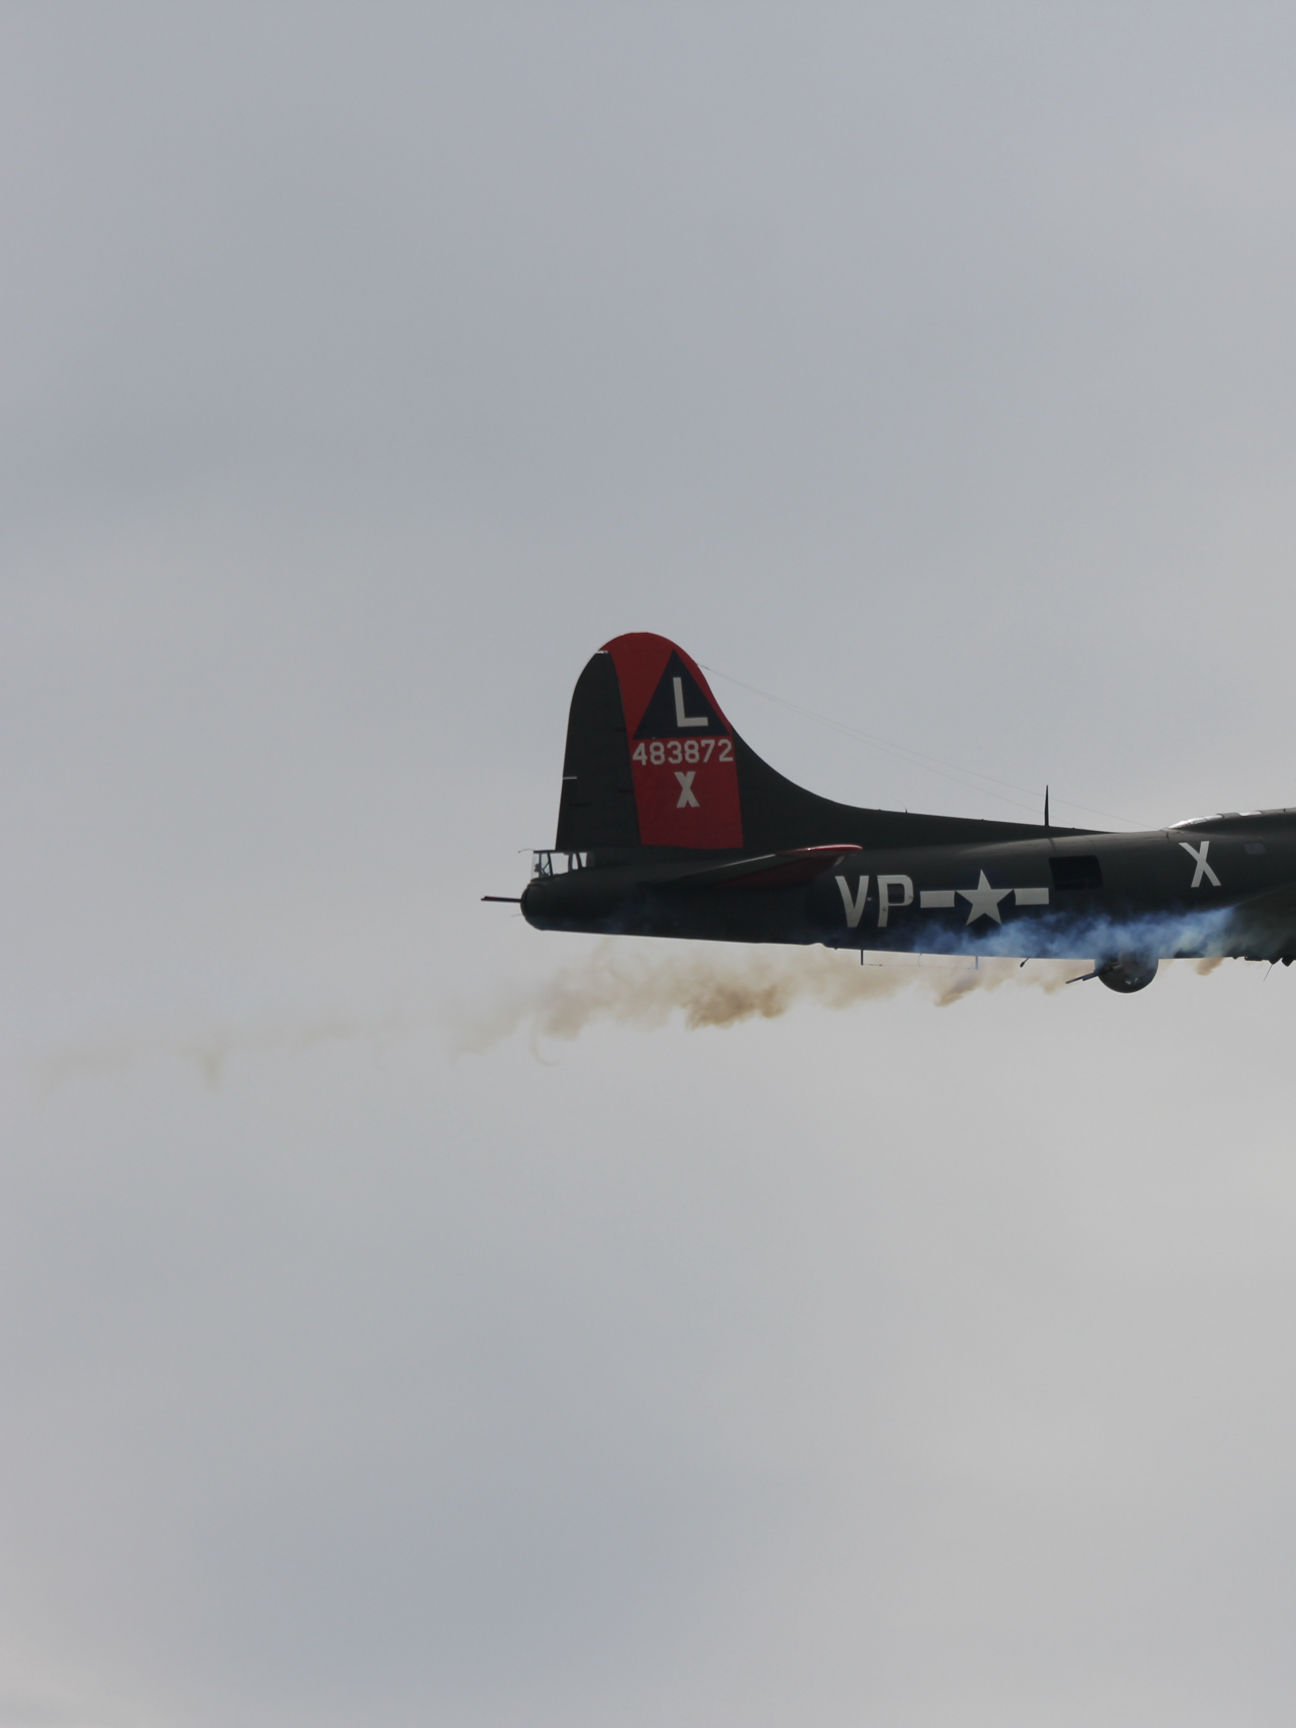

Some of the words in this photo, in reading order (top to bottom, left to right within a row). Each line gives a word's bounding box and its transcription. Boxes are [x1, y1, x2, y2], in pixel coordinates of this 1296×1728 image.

[673, 677, 709, 727] L
[632, 739, 734, 766] 483872
[674, 771, 700, 808] X
[1179, 840, 1222, 888] X
[835, 874, 914, 928] VP
